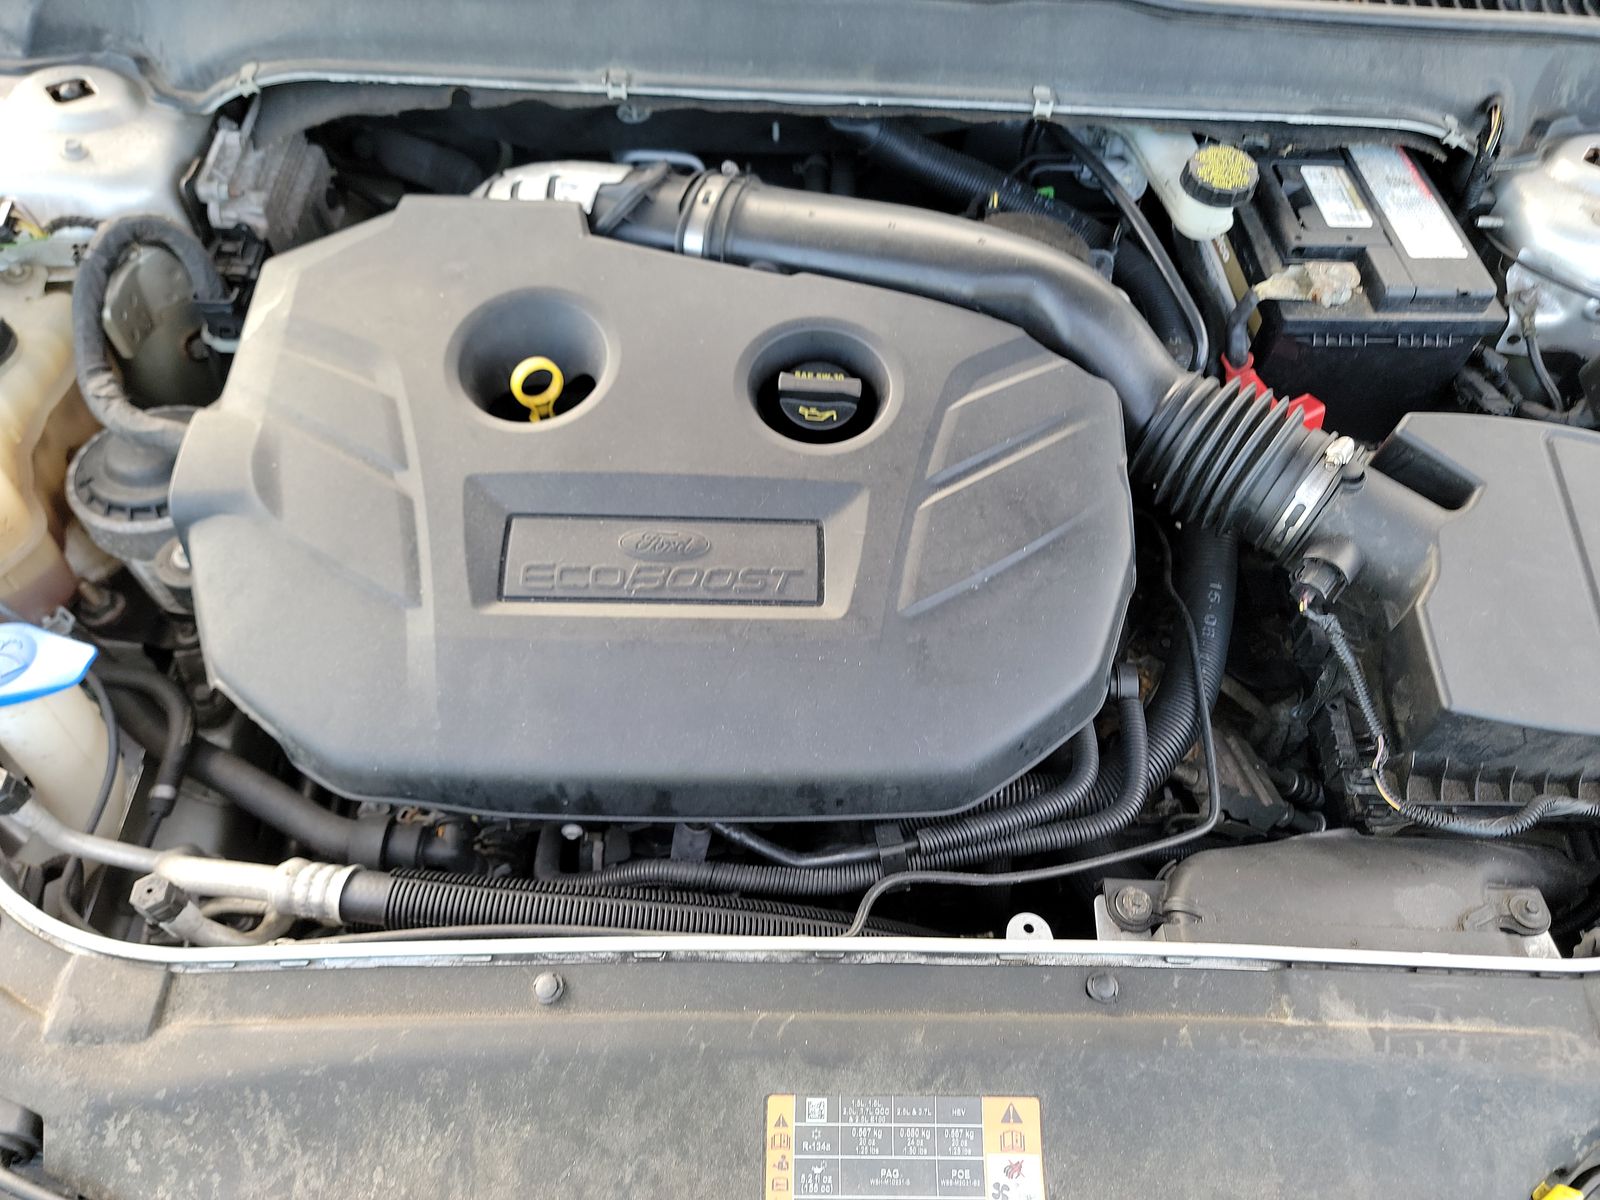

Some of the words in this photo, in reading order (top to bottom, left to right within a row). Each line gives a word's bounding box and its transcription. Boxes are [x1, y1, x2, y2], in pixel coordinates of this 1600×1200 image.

[635, 530, 695, 554] Ford
[873, 1127, 883, 1139] kg
[921, 1128, 931, 1140] kg
[965, 1129, 975, 1140] kg
[802, 1141, 831, 1152] R-134a
[960, 1139, 968, 1147] oz
[822, 1175, 833, 1184] oz
